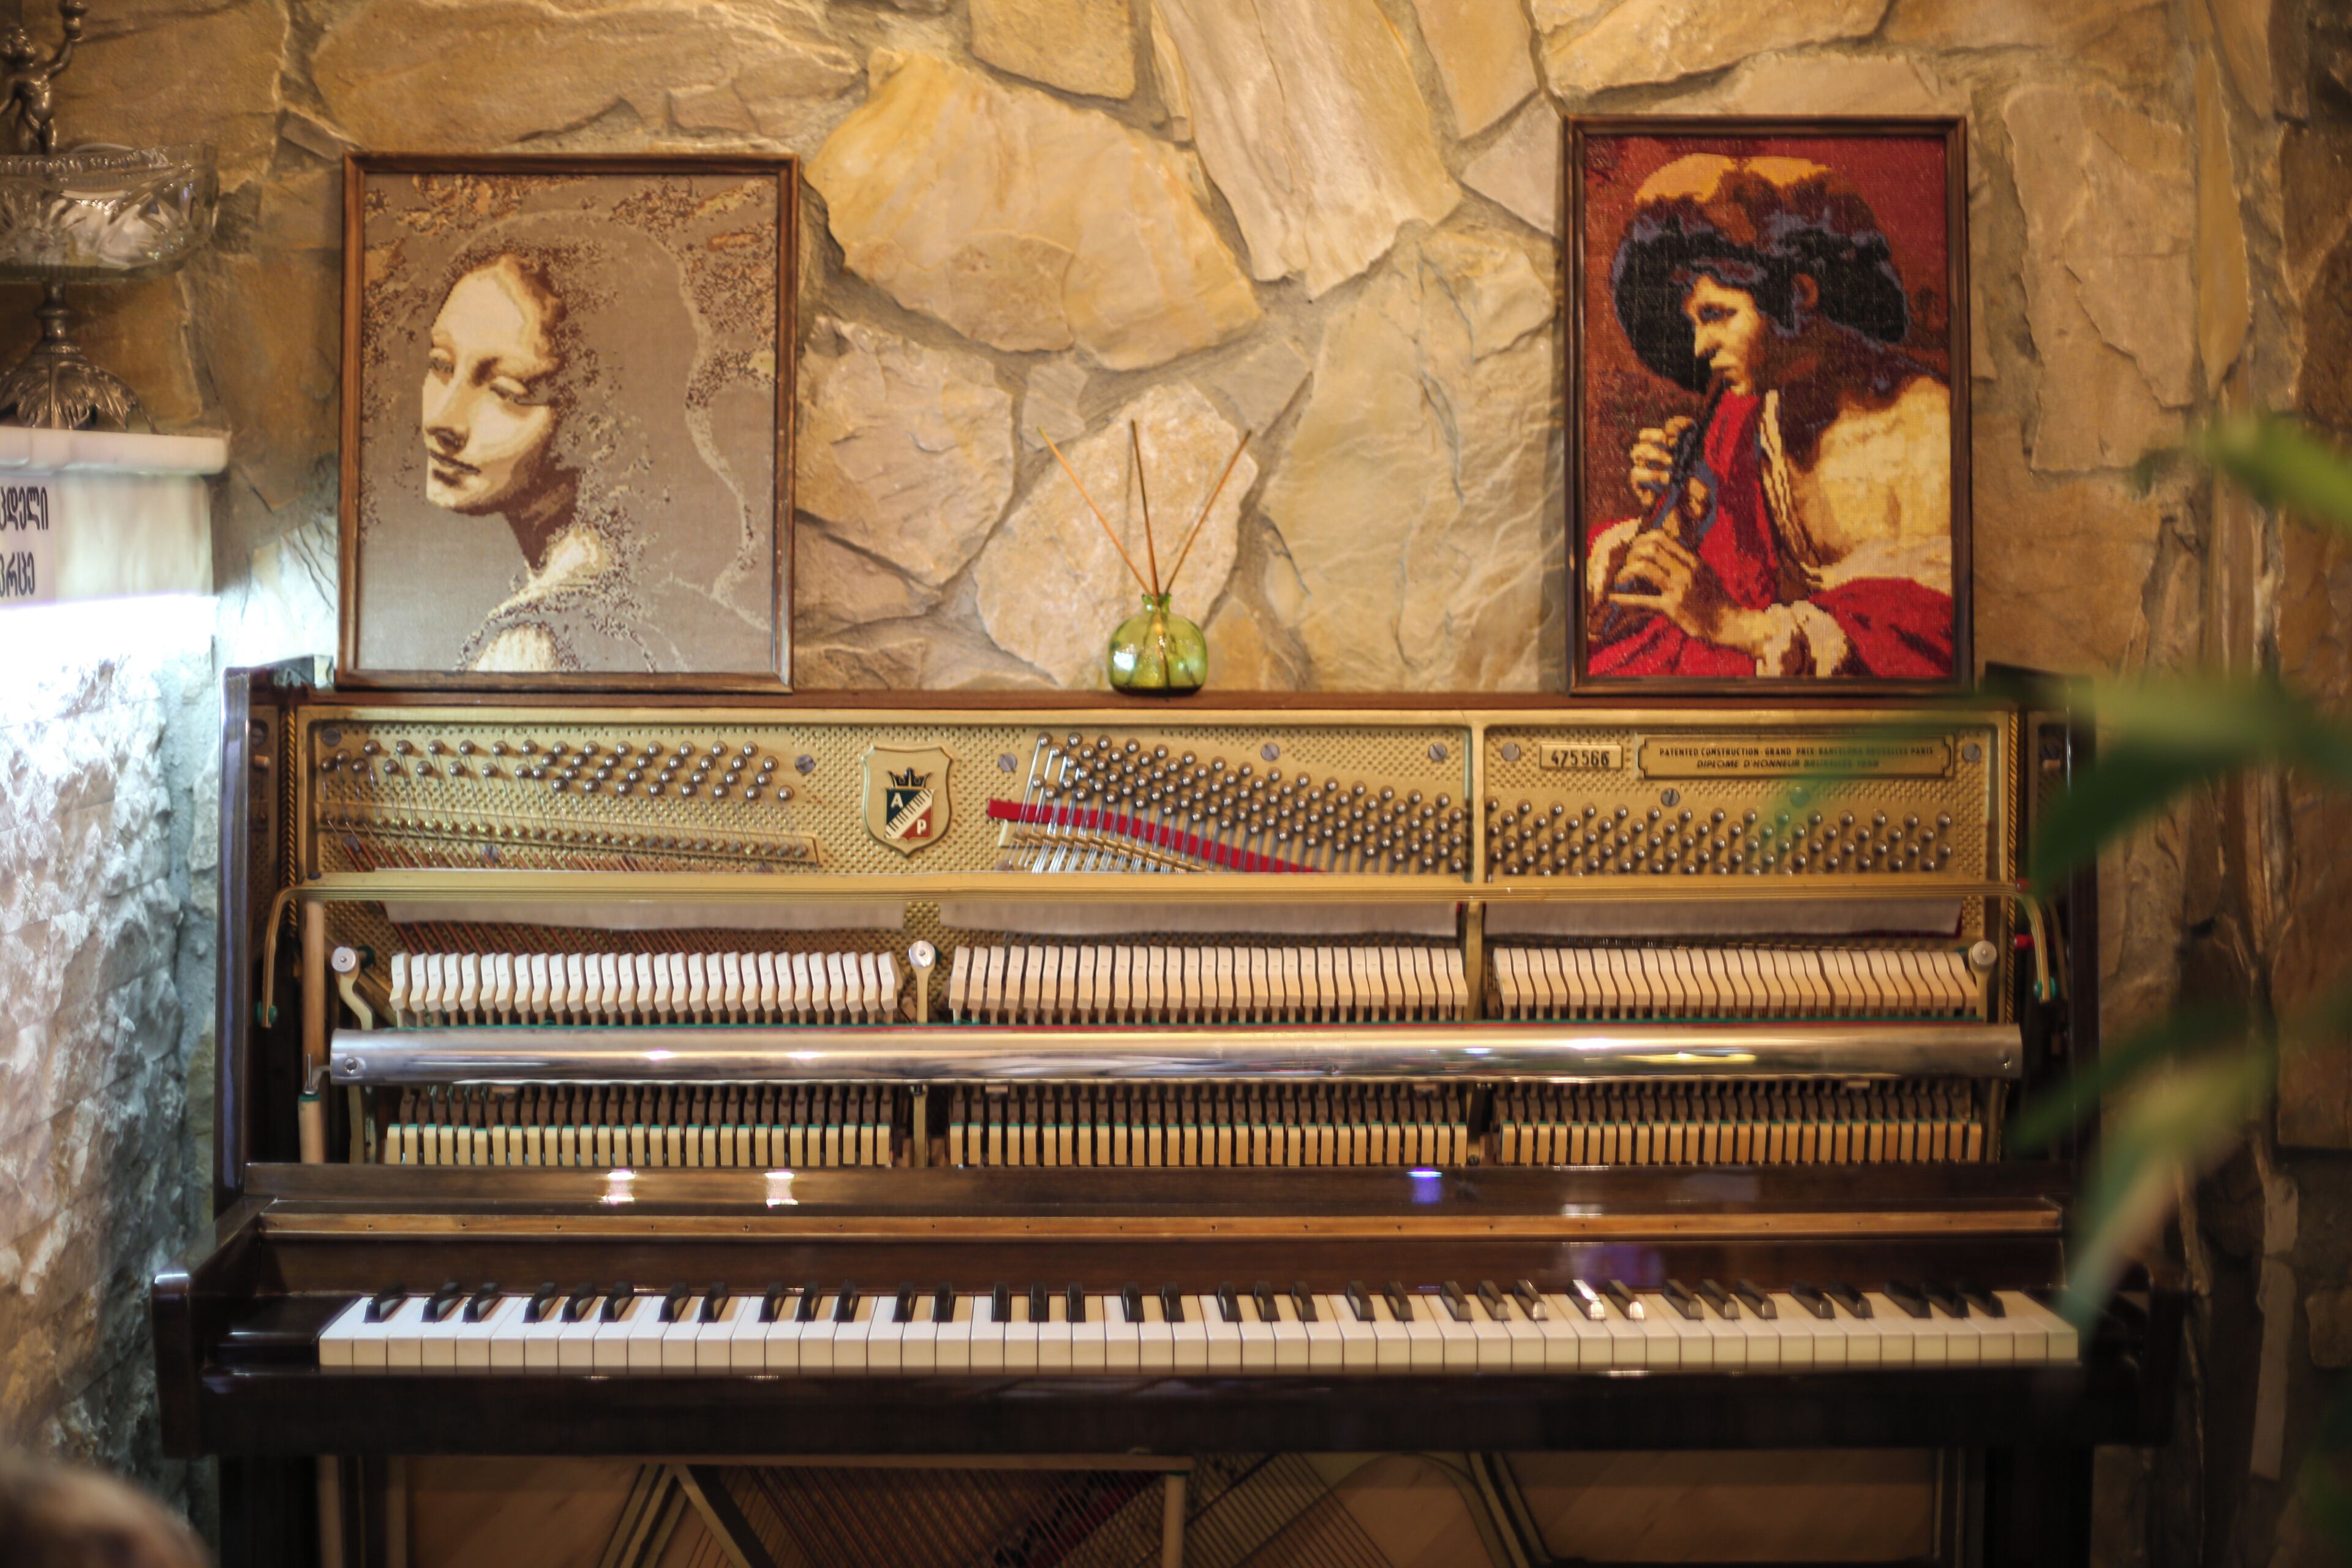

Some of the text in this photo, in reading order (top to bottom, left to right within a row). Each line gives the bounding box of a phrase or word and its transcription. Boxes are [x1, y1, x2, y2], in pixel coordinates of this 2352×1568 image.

[1659, 747, 1698, 757] PATENTED
[1701, 747, 1758, 756] CONSTRUCTION
[1765, 747, 1791, 756] GRAND
[1796, 747, 1814, 755] PRIX
[1910, 747, 1933, 755] PARIS
[1697, 760, 1738, 768] DIPLOME
[1743, 759, 1800, 767] D'HONNEUR
[891, 793, 903, 809] A
[916, 819, 927, 834] P
